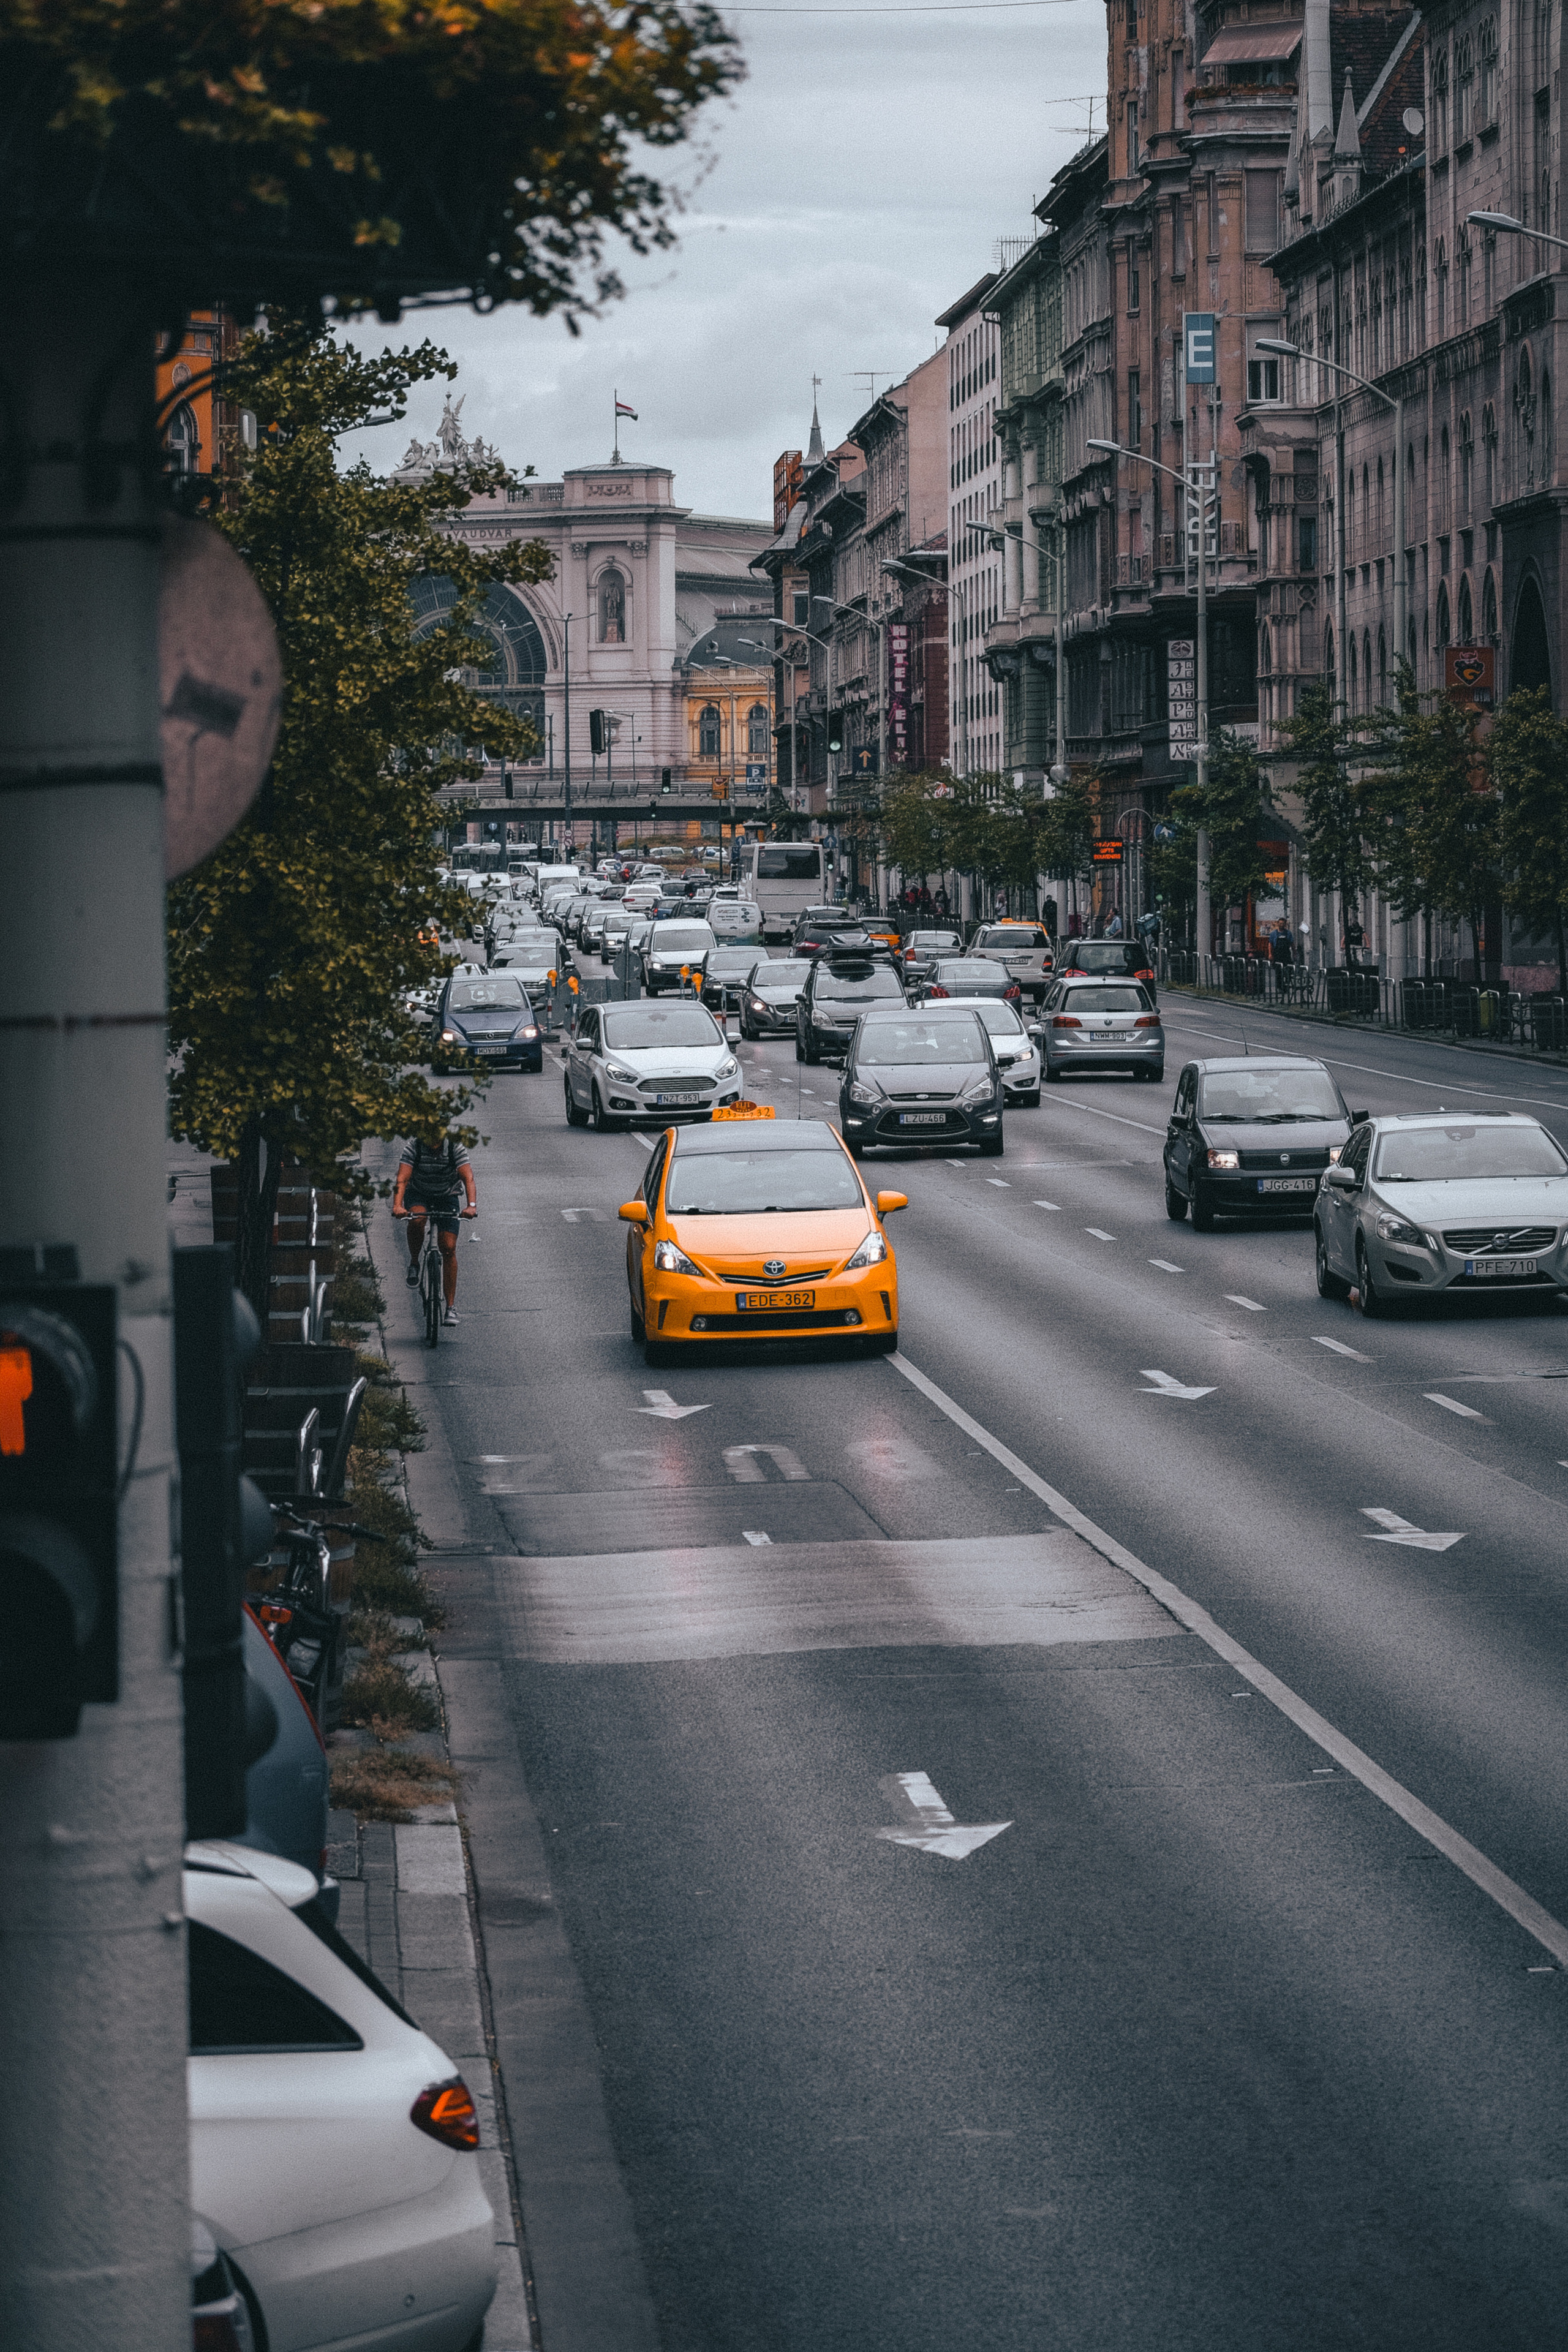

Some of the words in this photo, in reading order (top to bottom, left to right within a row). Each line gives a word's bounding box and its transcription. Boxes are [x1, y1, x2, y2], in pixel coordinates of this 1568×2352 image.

[1188, 330, 1213, 368] E
[1188, 450, 1216, 556] ERKEL
[892, 625, 907, 692] HOTEL
[663, 1095, 697, 1103] NZT-953
[1265, 1180, 1313, 1190] JGG-416
[1476, 1261, 1534, 1273] PFE-710
[749, 1293, 810, 1306] EDE-362
